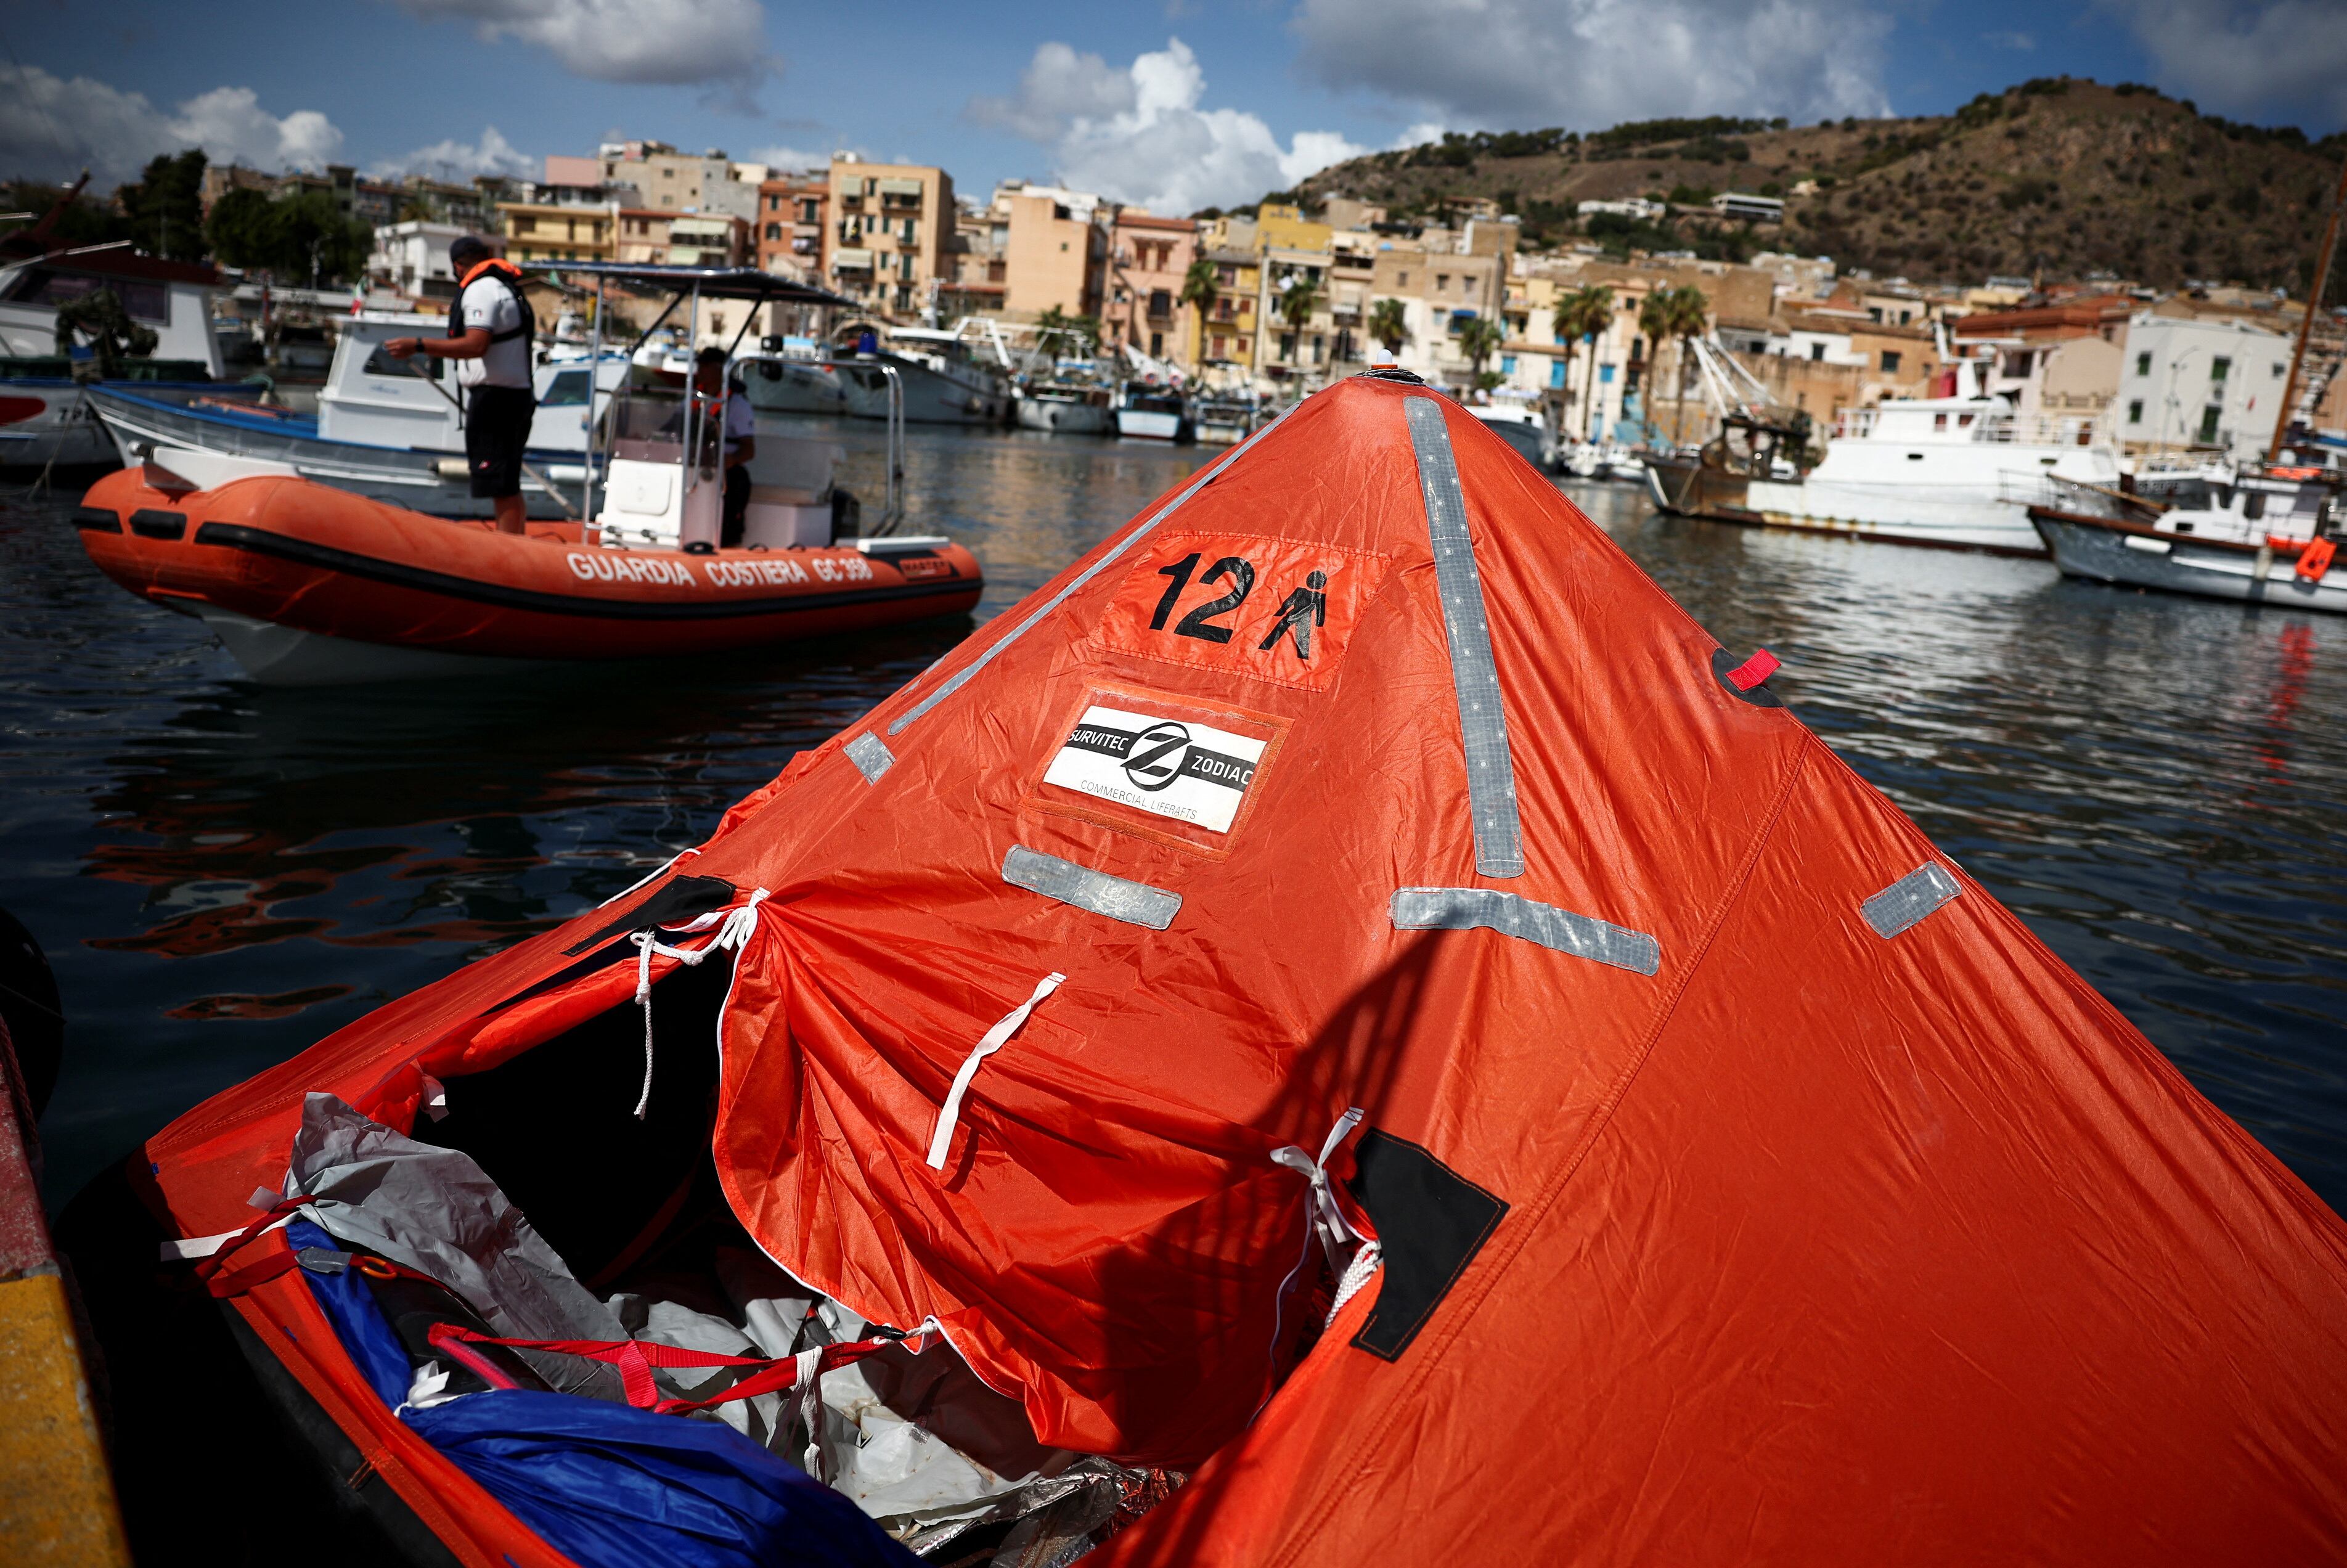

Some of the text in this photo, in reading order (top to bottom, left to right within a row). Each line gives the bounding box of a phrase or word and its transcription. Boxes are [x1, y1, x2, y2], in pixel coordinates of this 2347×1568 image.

[566, 552, 697, 587] GUARDIA
[704, 560, 810, 586] COSTIERA
[812, 558, 844, 582] GC
[1149, 552, 1255, 643] 12
[1067, 729, 1129, 751] SURVITEC
[1191, 754, 1255, 785] ZODIAC
[1080, 780, 1198, 820] COMMERCIAL LIFERAFTS
